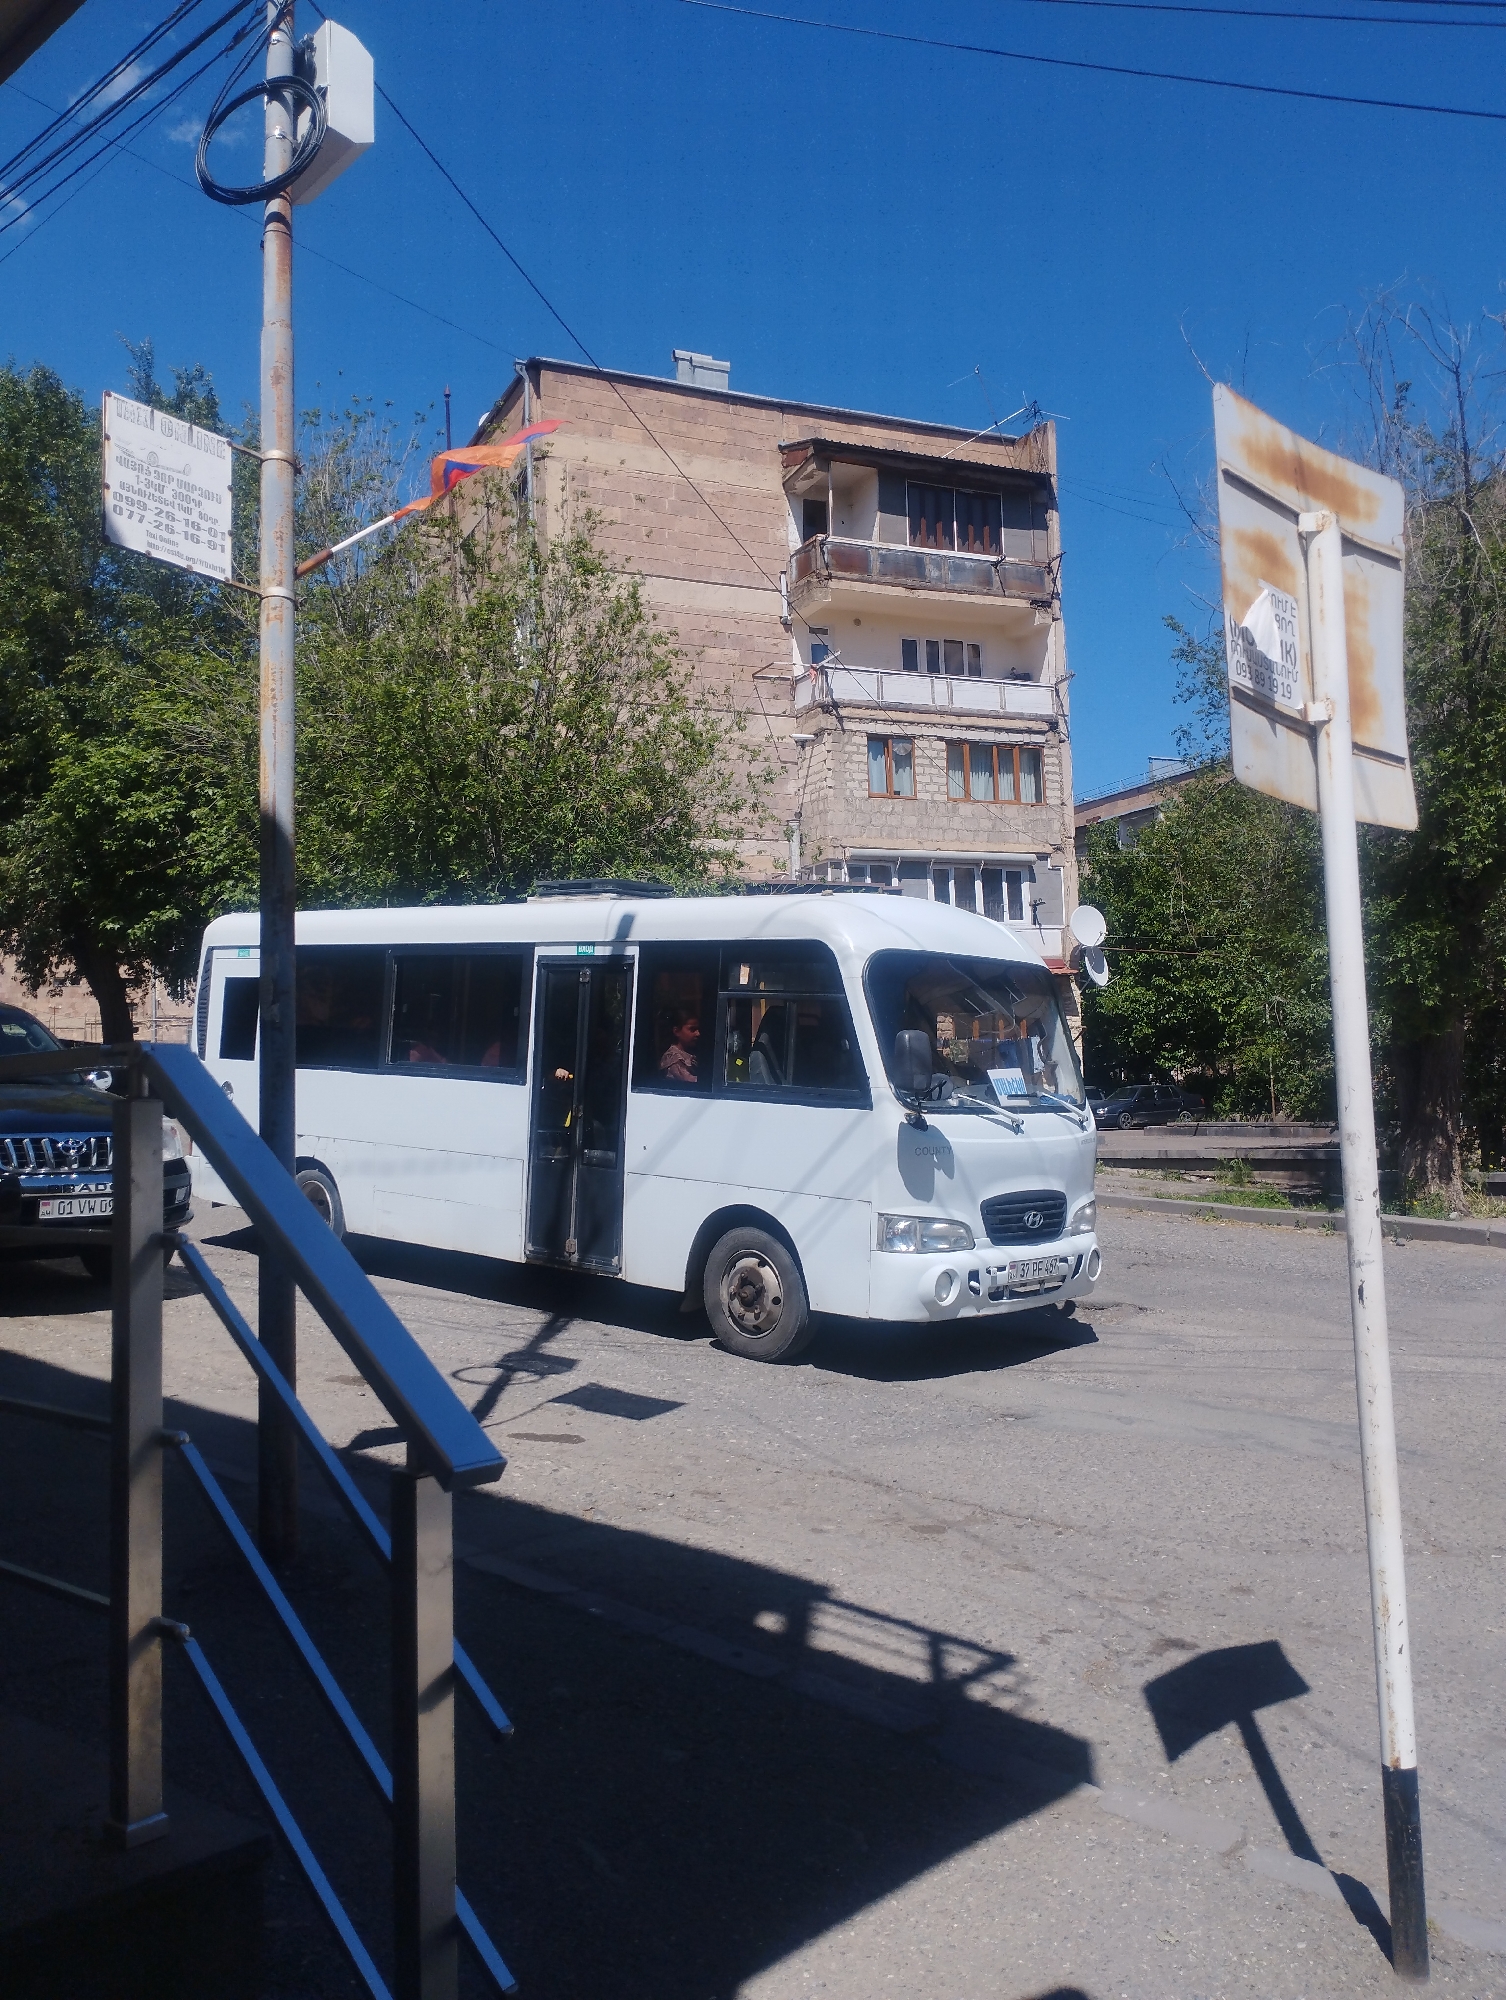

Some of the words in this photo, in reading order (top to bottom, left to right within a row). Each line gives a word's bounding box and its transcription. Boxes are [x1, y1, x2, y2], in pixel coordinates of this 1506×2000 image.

[113, 504, 226, 553] 077-26-16-91
[1236, 660, 1252, 680] 093
[1254, 669, 1266, 688] 89
[1267, 676, 1279, 694] 19
[1281, 682, 1292, 700] 19
[914, 1146, 952, 1157] COUNTY
[58, 1200, 73, 1215] 01
[78, 1199, 97, 1214] VW
[1020, 1262, 1030, 1278] 37
[1032, 1260, 1043, 1277] PF
